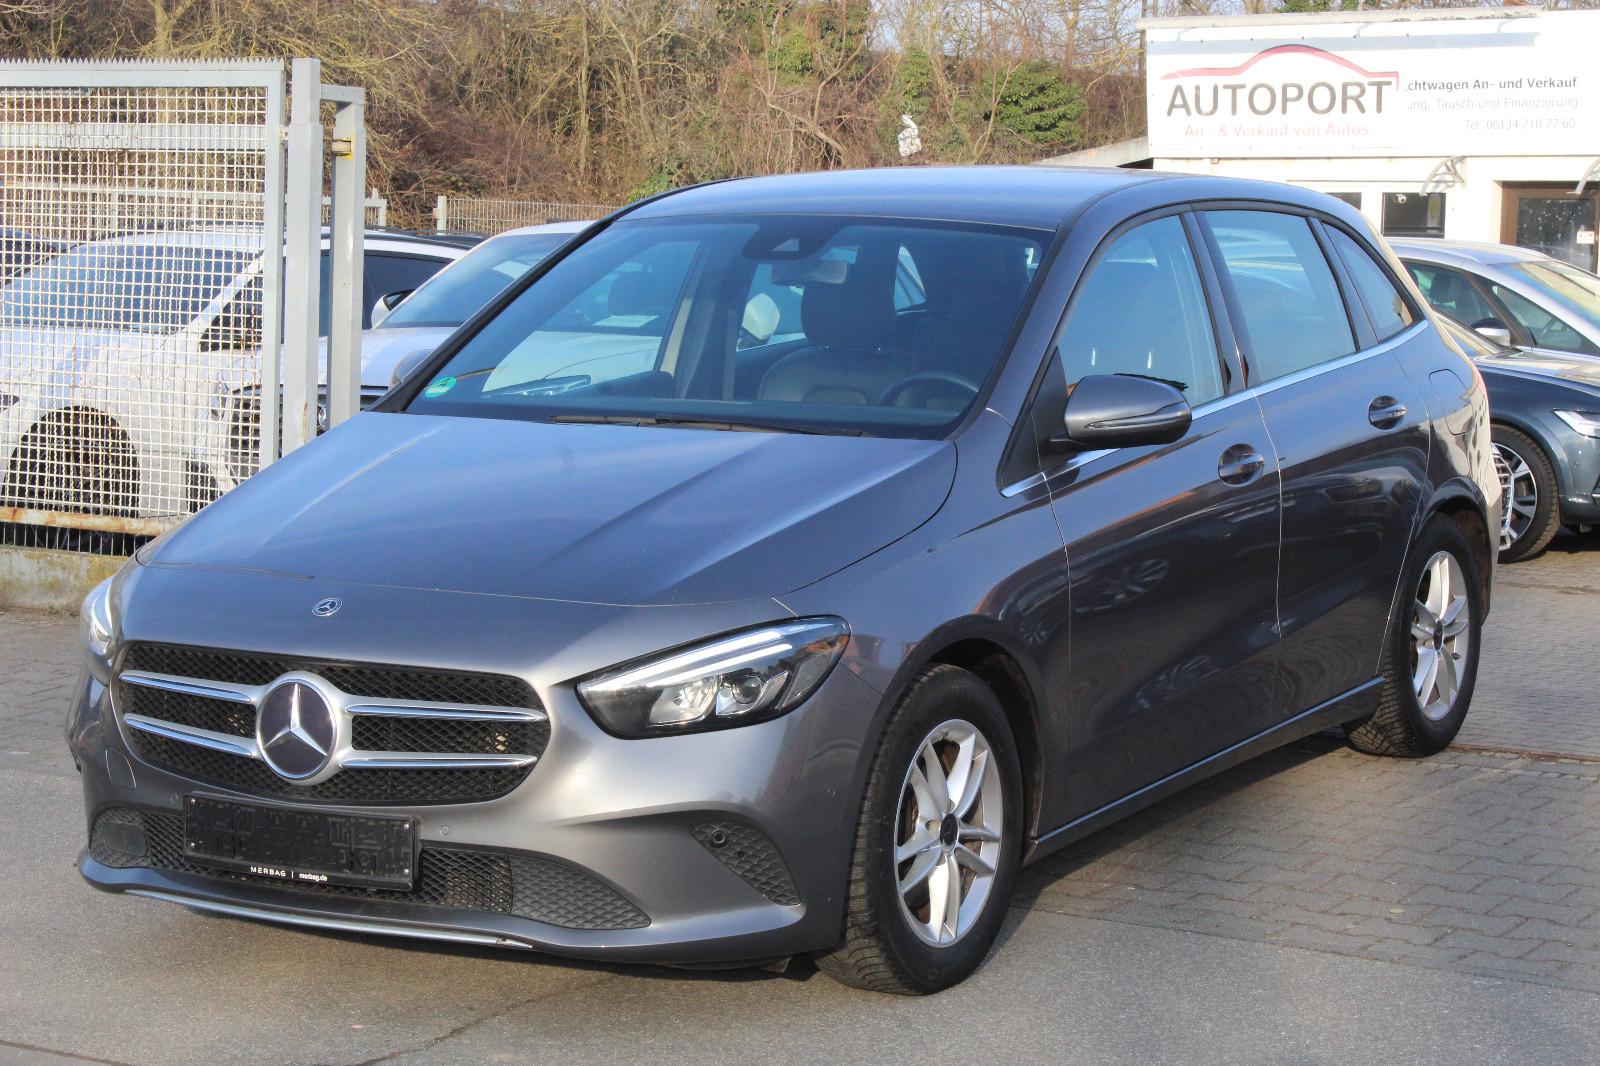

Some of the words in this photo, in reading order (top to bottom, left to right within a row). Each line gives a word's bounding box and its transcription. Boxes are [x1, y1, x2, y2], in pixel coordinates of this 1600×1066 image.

[1472, 79, 1495, 89] An-
[1499, 77, 1523, 89] und
[1527, 76, 1578, 89] Verkauf
[1166, 80, 1393, 117] AUTOPORT
[1436, 97, 1474, 110] Tausch
[1478, 97, 1500, 109] und
[1504, 96, 1578, 112] Finanzierung
[1233, 124, 1288, 137] Verkauf
[1293, 126, 1319, 137] von
[1325, 123, 1370, 137] Autos
[1522, 118, 1541, 129] 210
[250, 866, 286, 877] MERBAG
[299, 873, 328, 882] merbag.de
